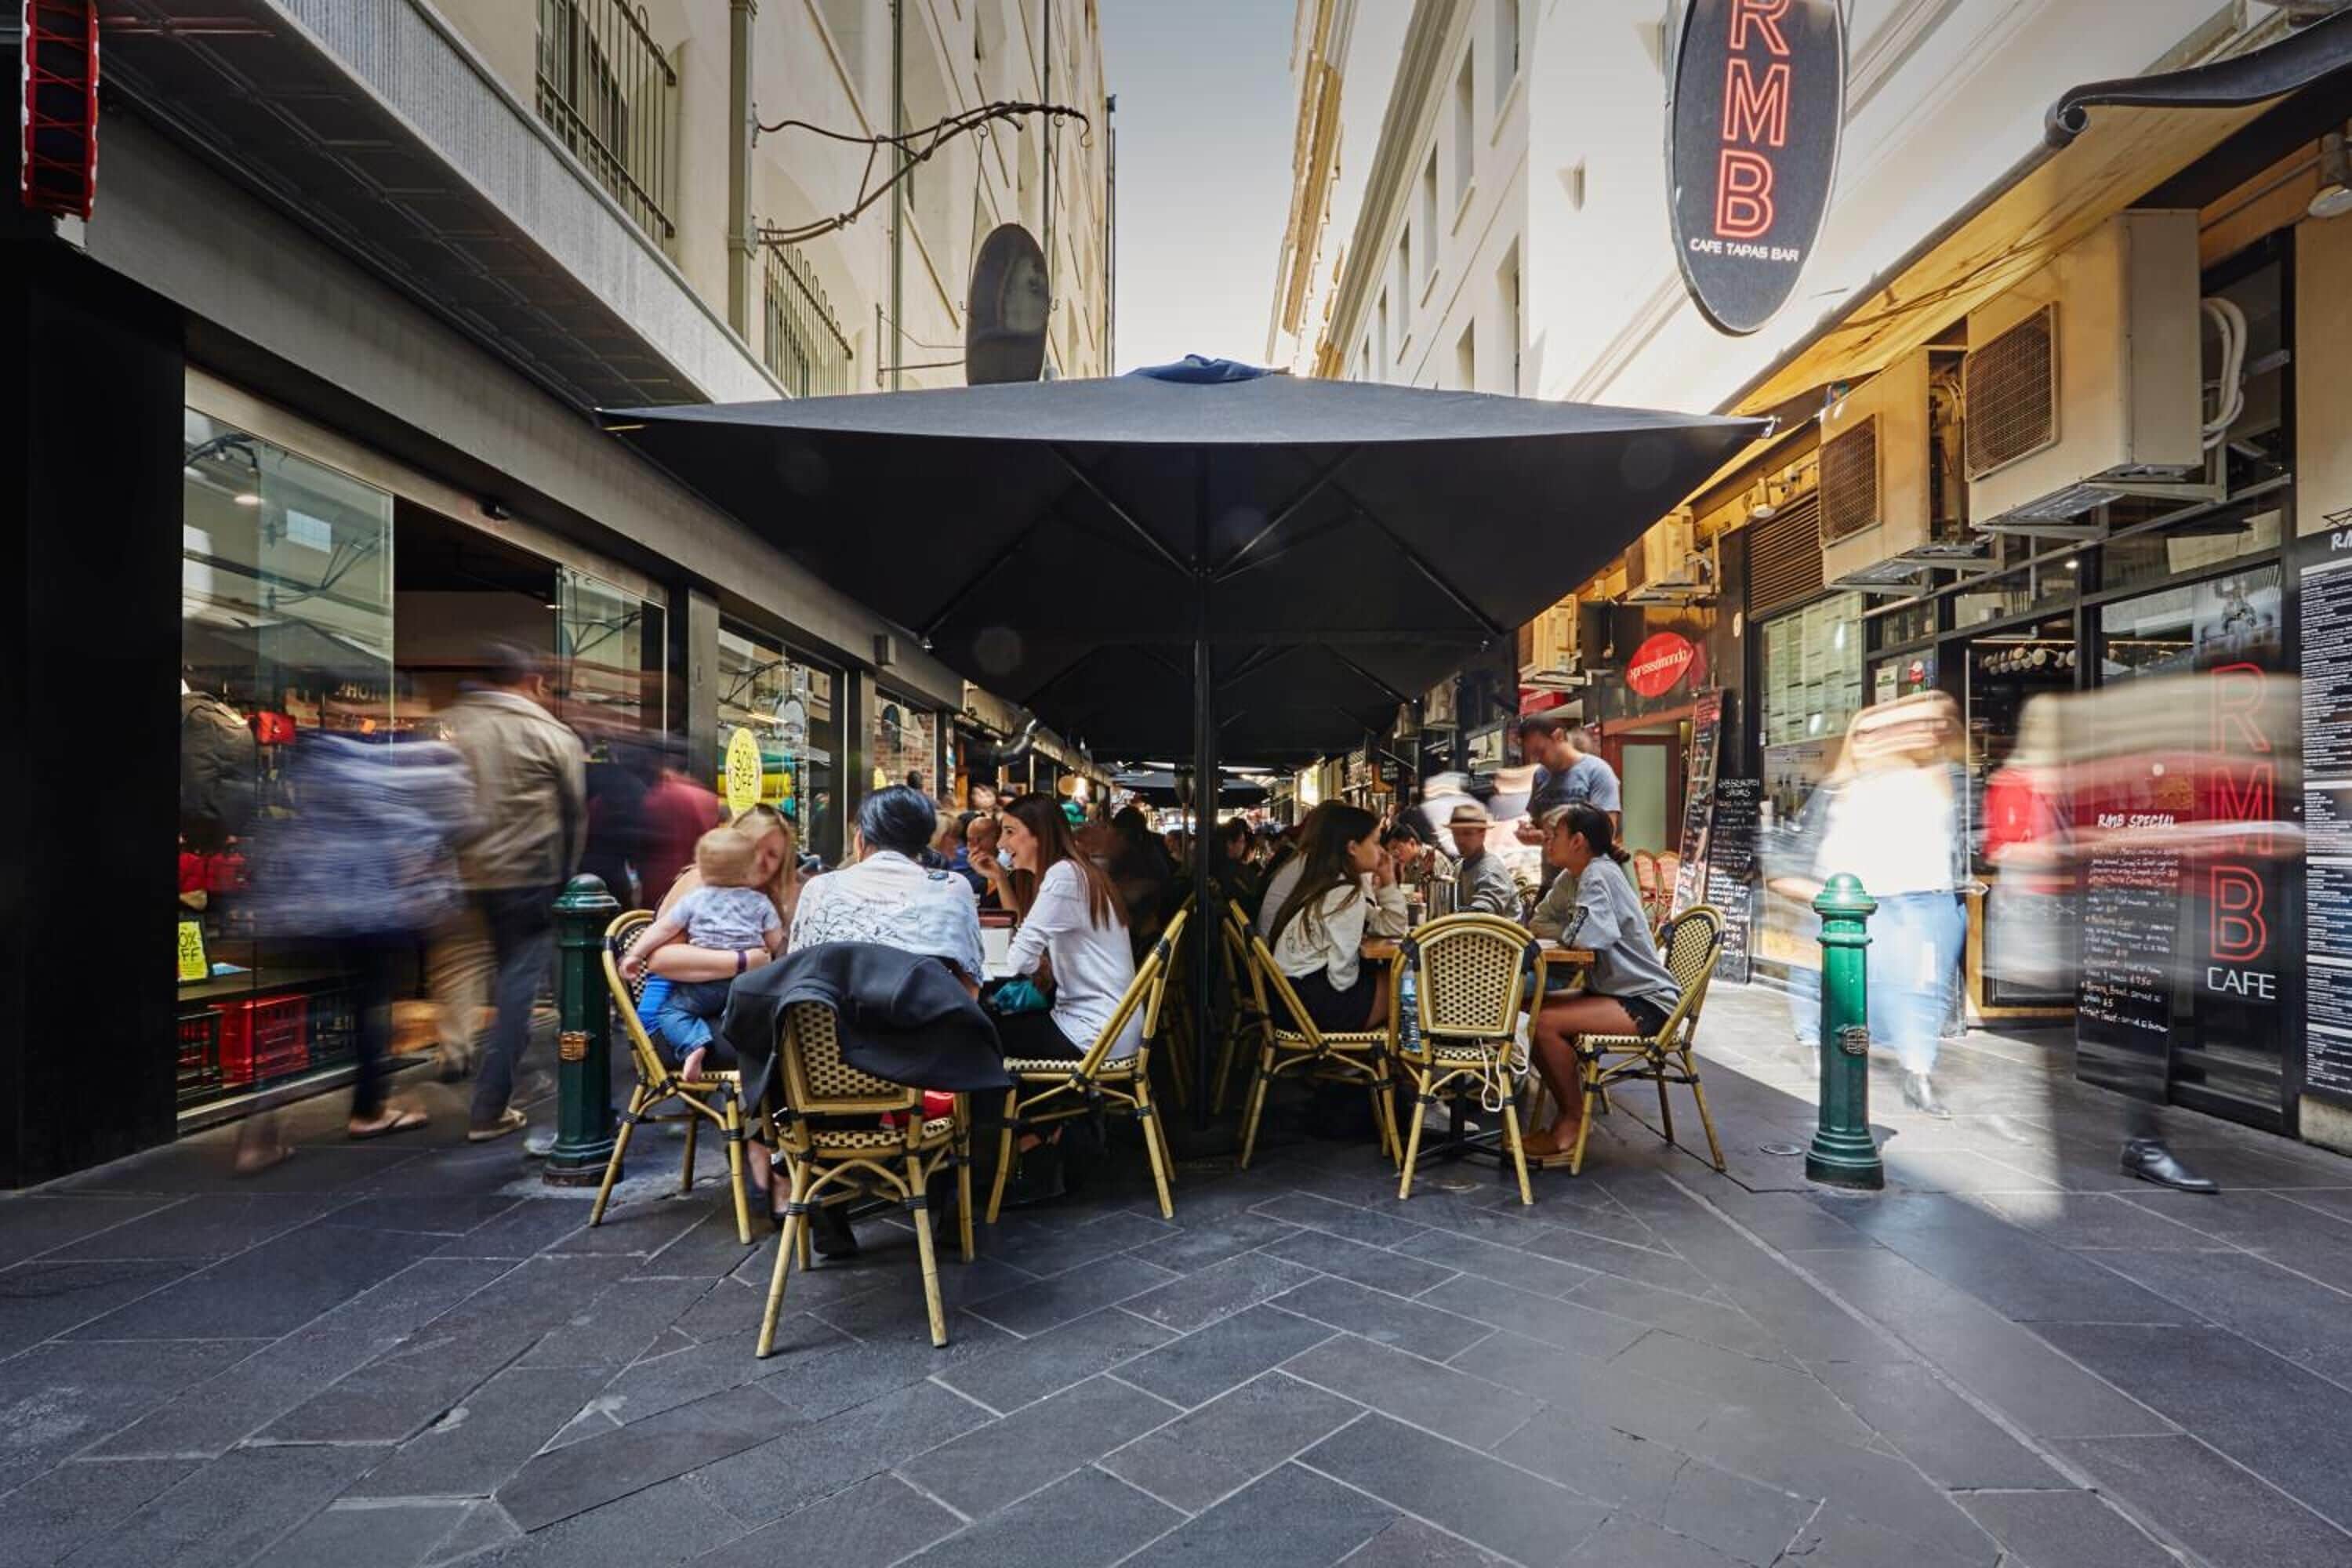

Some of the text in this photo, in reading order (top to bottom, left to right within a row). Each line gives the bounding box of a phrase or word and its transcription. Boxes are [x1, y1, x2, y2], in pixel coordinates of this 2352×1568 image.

[1714, 0, 1791, 238] RMB
[1690, 238, 1798, 263] CAFE TAPAS BAR
[2097, 813, 2177, 829] RMB SPECIAL
[2209, 662, 2274, 962] RMB
[2207, 967, 2276, 1000] CAFE
